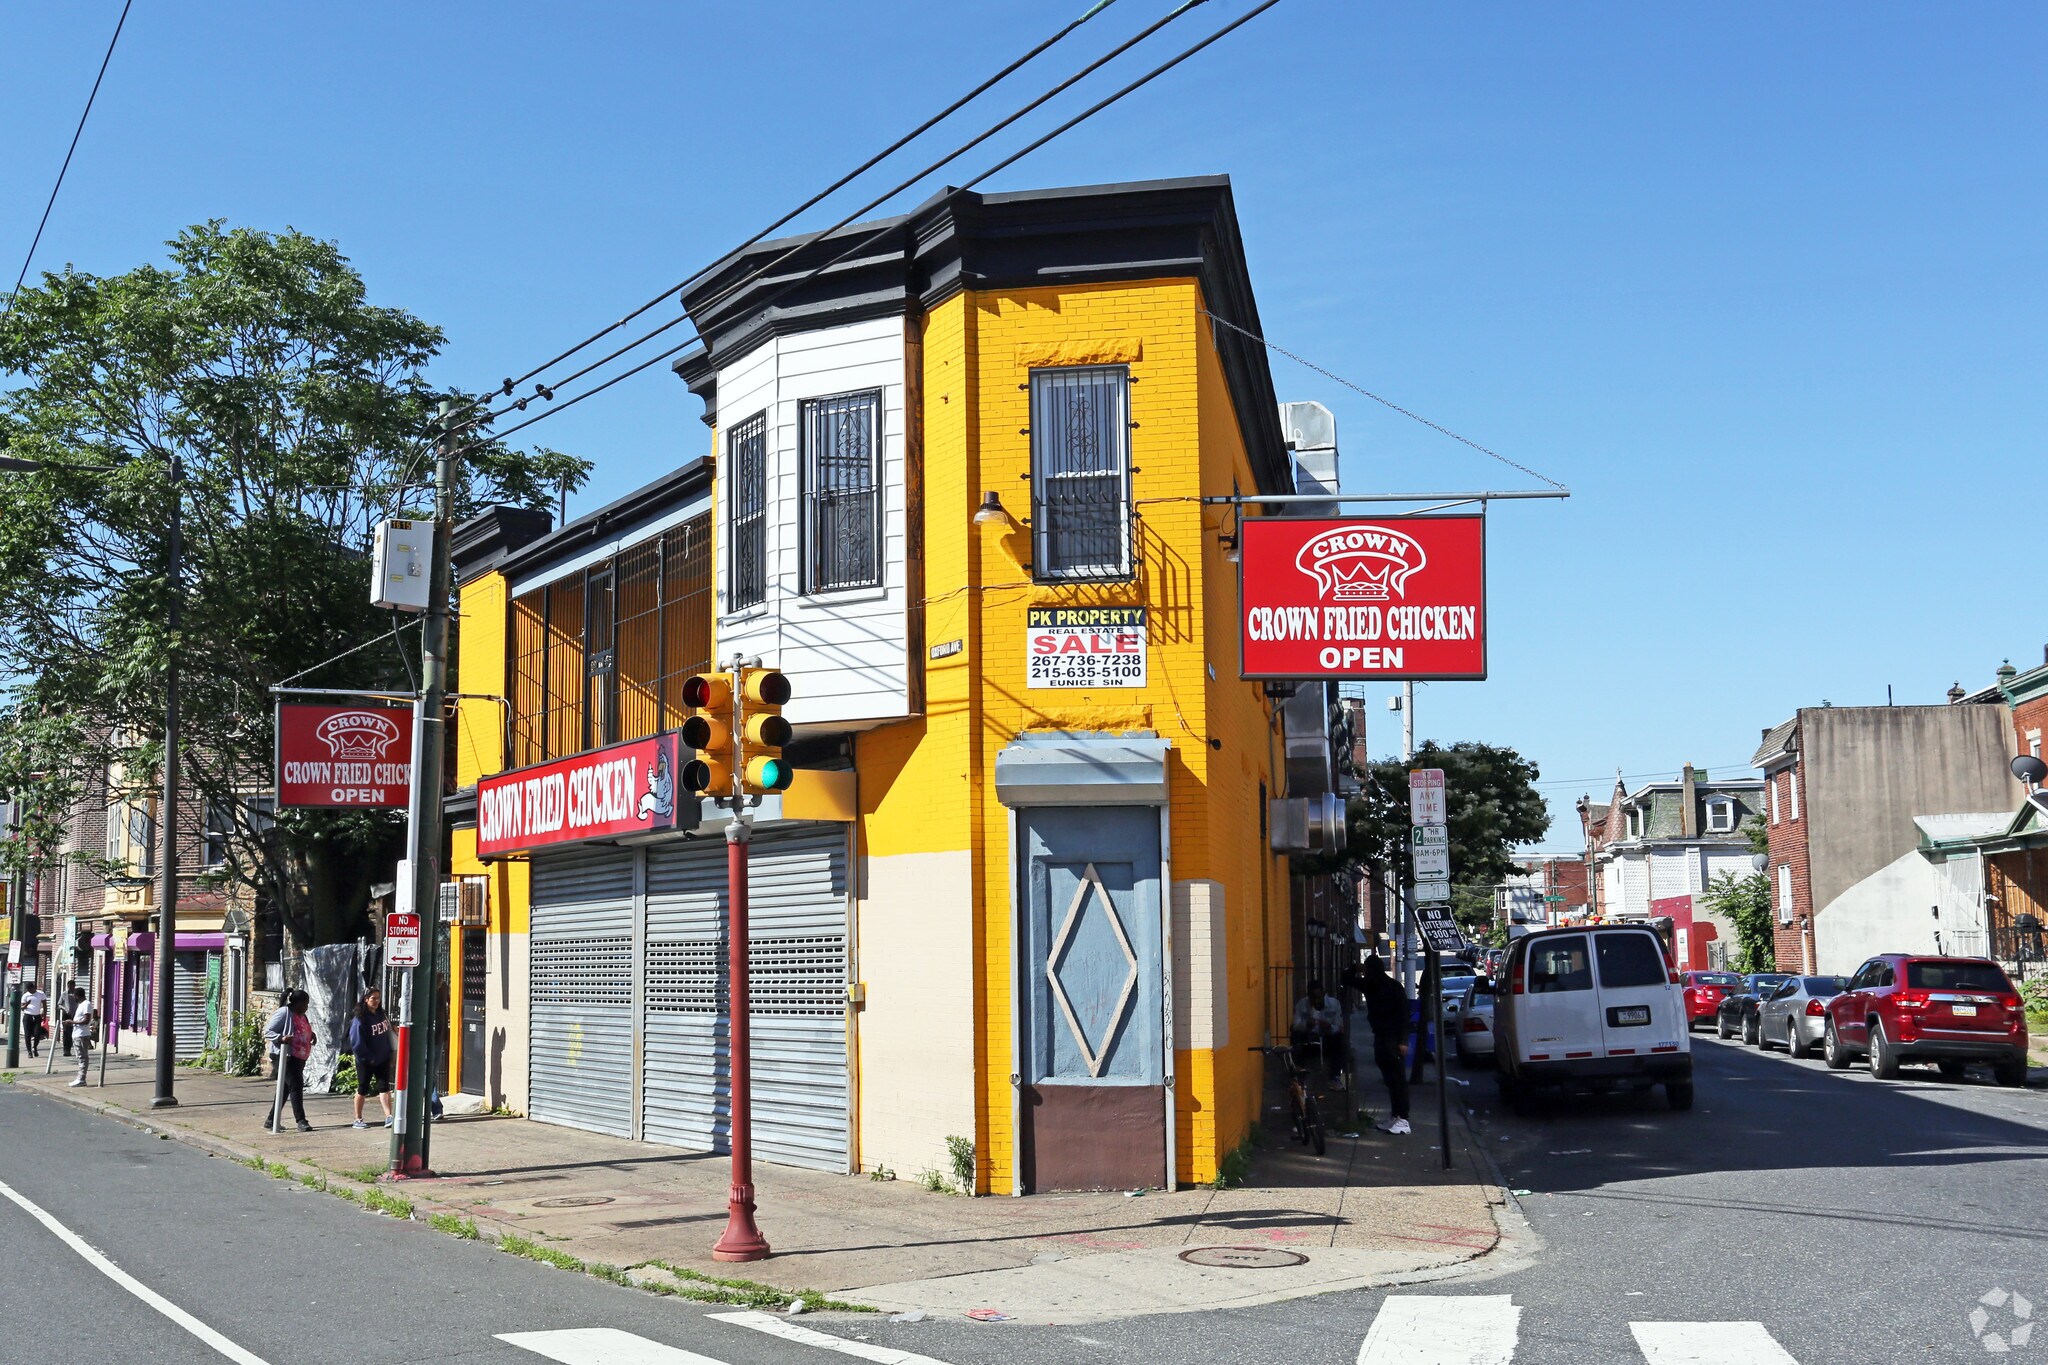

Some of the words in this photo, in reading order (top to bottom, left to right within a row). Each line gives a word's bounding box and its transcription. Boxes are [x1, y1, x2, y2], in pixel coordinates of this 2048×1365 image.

[1312, 532, 1409, 558] CROWN
[1029, 610, 1052, 626] PK
[1056, 609, 1143, 626] PROPERTY
[1248, 605, 1319, 641] CROWN
[1323, 606, 1382, 641] FRIED
[1386, 605, 1476, 641] CHICKEN
[1033, 634, 1139, 655] SALE
[1032, 655, 1141, 666] 267-736-7238
[1319, 647, 1403, 669] OPEN
[1032, 667, 1141, 678] 215-635-5100
[327, 716, 389, 732] CROWN
[284, 761, 331, 785] CROWN
[334, 762, 371, 785] FRIED
[374, 763, 411, 785] CHICK
[1423, 771, 1431, 779] NO
[1413, 779, 1441, 787] STOPPING
[331, 788, 385, 803] OPEN
[480, 781, 523, 842] CROWN
[524, 772, 565, 836] FRIED
[567, 756, 637, 829] CHICKEN
[1420, 791, 1435, 800] ANY
[1419, 803, 1438, 812] TIME
[1415, 829, 1421, 844] 2
[1424, 836, 1445, 844] PARKING
[1415, 849, 1446, 857] 8AM-6PM
[1426, 910, 1441, 919] NO
[398, 916, 409, 925] NO
[1422, 920, 1454, 929] LITTERING
[389, 927, 418, 936] STOPPING
